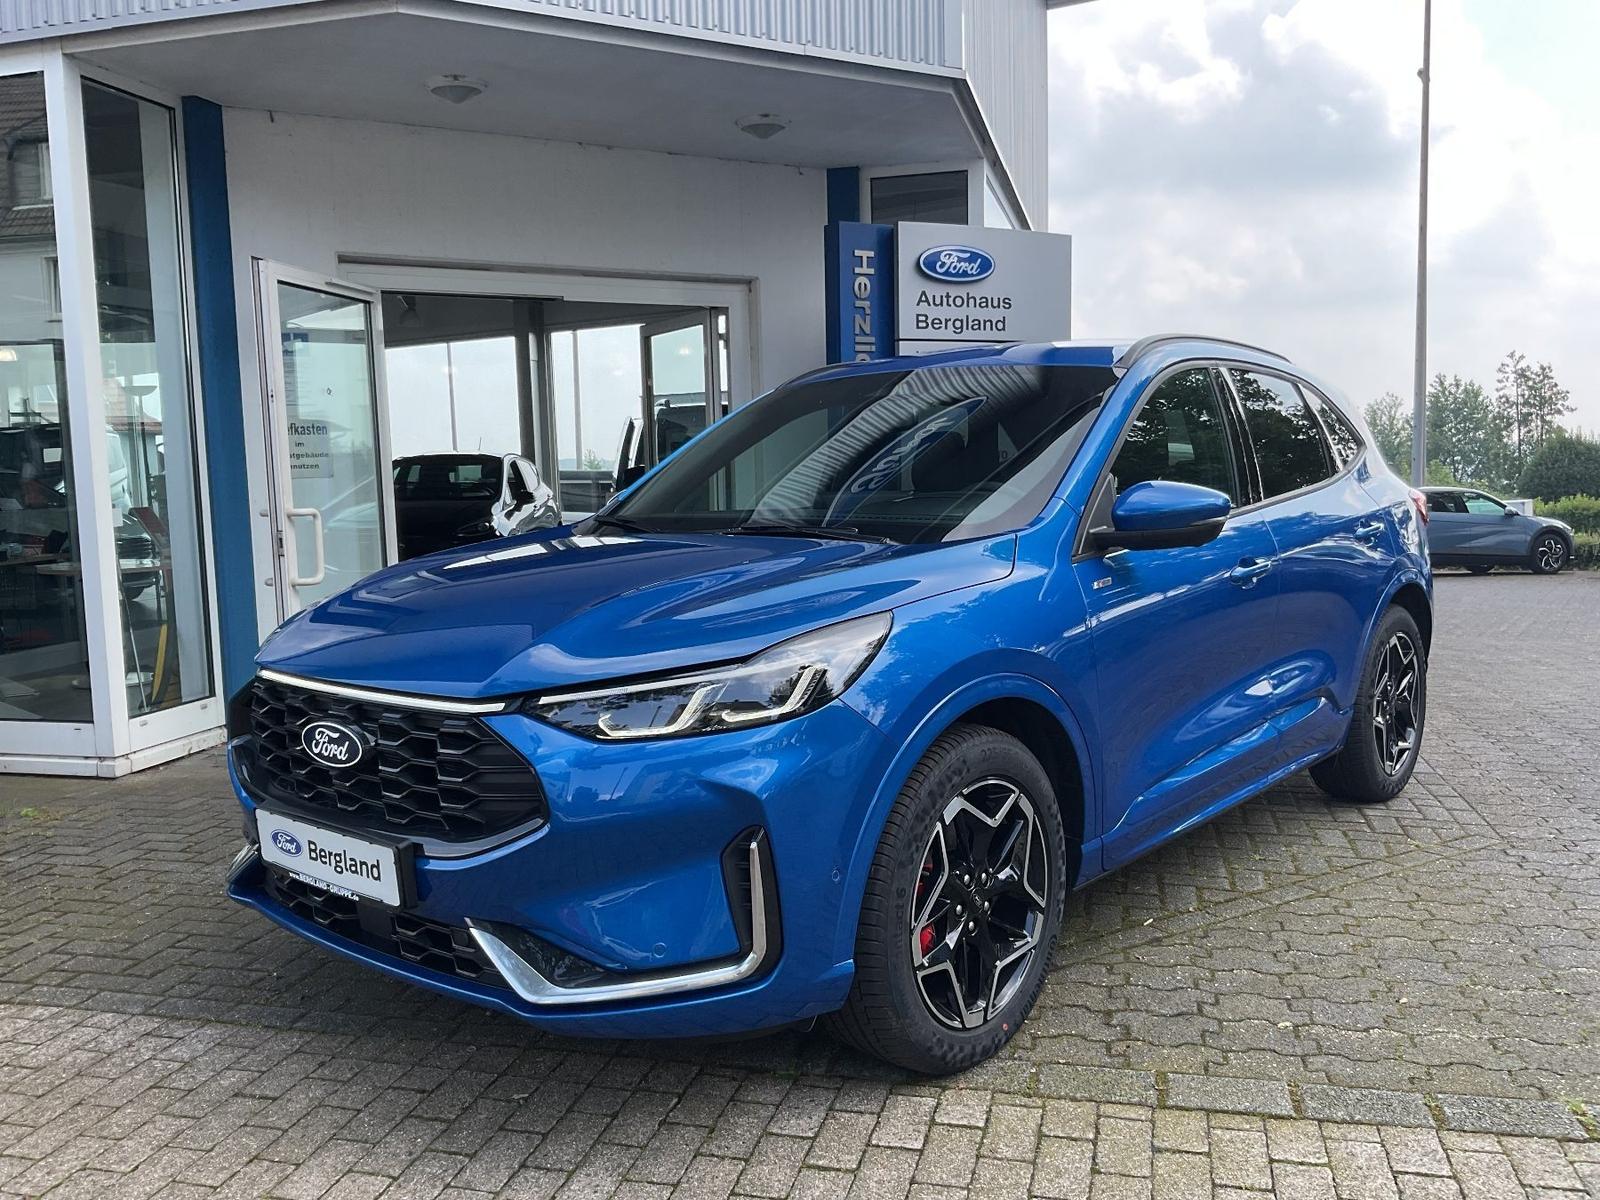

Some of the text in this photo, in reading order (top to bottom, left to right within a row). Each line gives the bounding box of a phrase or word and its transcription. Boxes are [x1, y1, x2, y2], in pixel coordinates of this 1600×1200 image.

[935, 249, 981, 275] Ford
[916, 290, 1012, 310] Autohaus
[915, 313, 1007, 335] Bergland
[312, 727, 349, 761] Ford
[276, 833, 297, 854] Ford
[307, 839, 382, 882] Bergland
